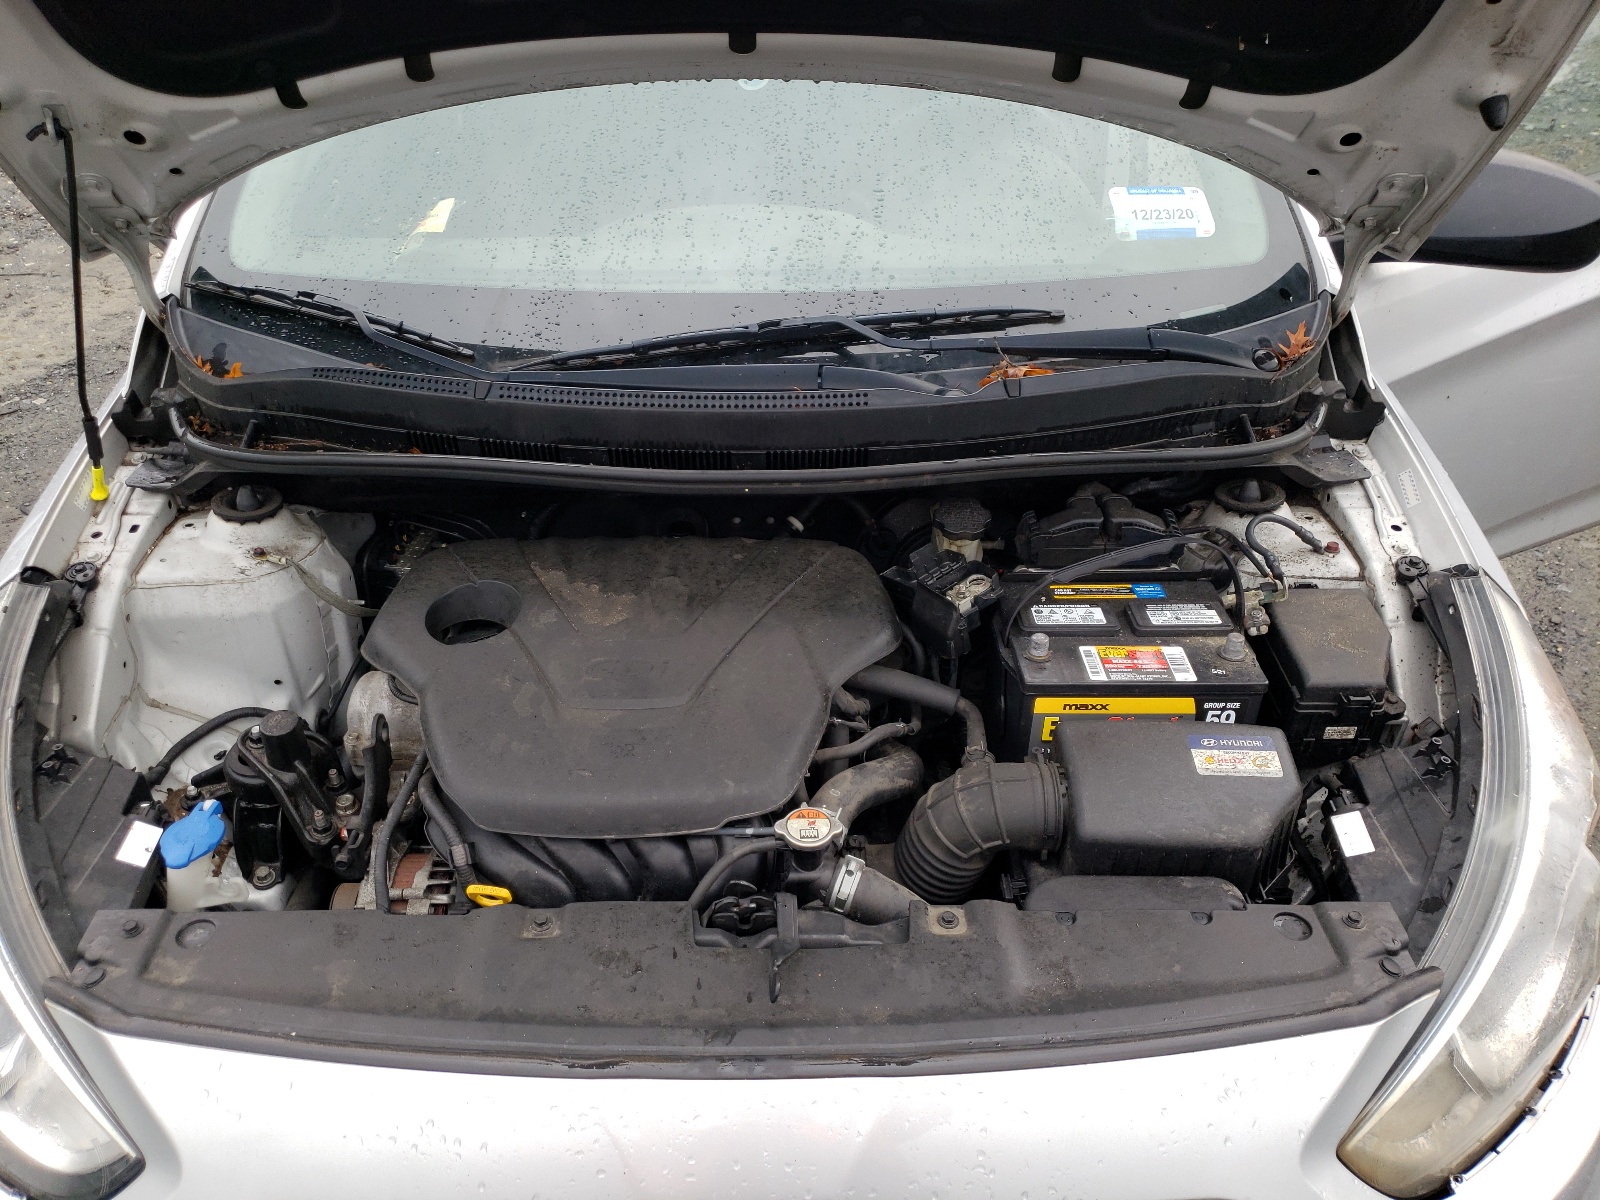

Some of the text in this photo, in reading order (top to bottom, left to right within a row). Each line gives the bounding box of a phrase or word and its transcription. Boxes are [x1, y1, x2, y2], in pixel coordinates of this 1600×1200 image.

[1131, 208, 1195, 221] 12/23/20
[1062, 703, 1110, 711] maxx
[1219, 739, 1264, 747] HYUNDAI
